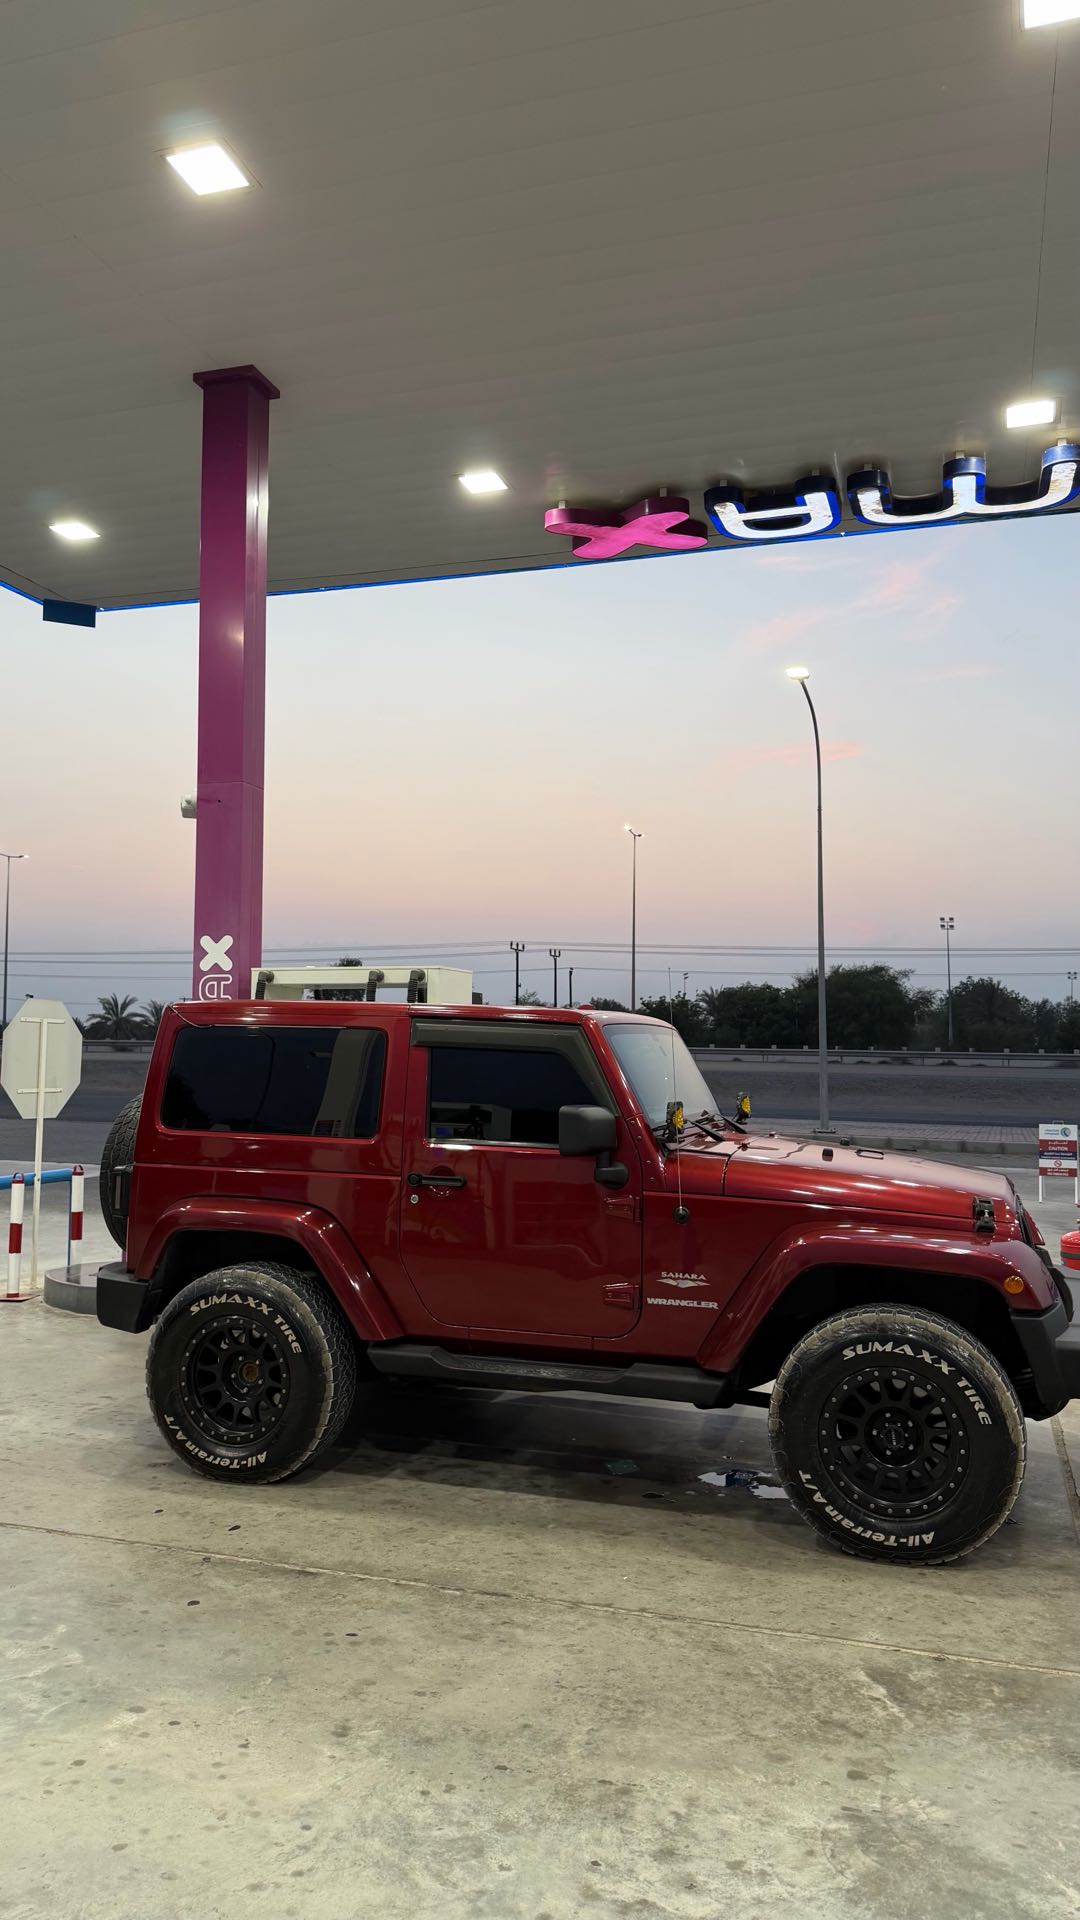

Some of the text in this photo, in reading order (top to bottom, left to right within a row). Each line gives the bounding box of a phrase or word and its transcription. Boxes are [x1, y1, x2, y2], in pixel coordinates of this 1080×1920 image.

[646, 1297, 719, 1310] WRANGLER
[661, 1271, 707, 1280] SAHARA
[189, 1293, 302, 1353] SUMAXX TIRE
[841, 1341, 993, 1425] SUMAXX TIRE
[163, 1413, 268, 1469] All-Terrain A/T
[798, 1470, 936, 1547] All-Terrain A/T
